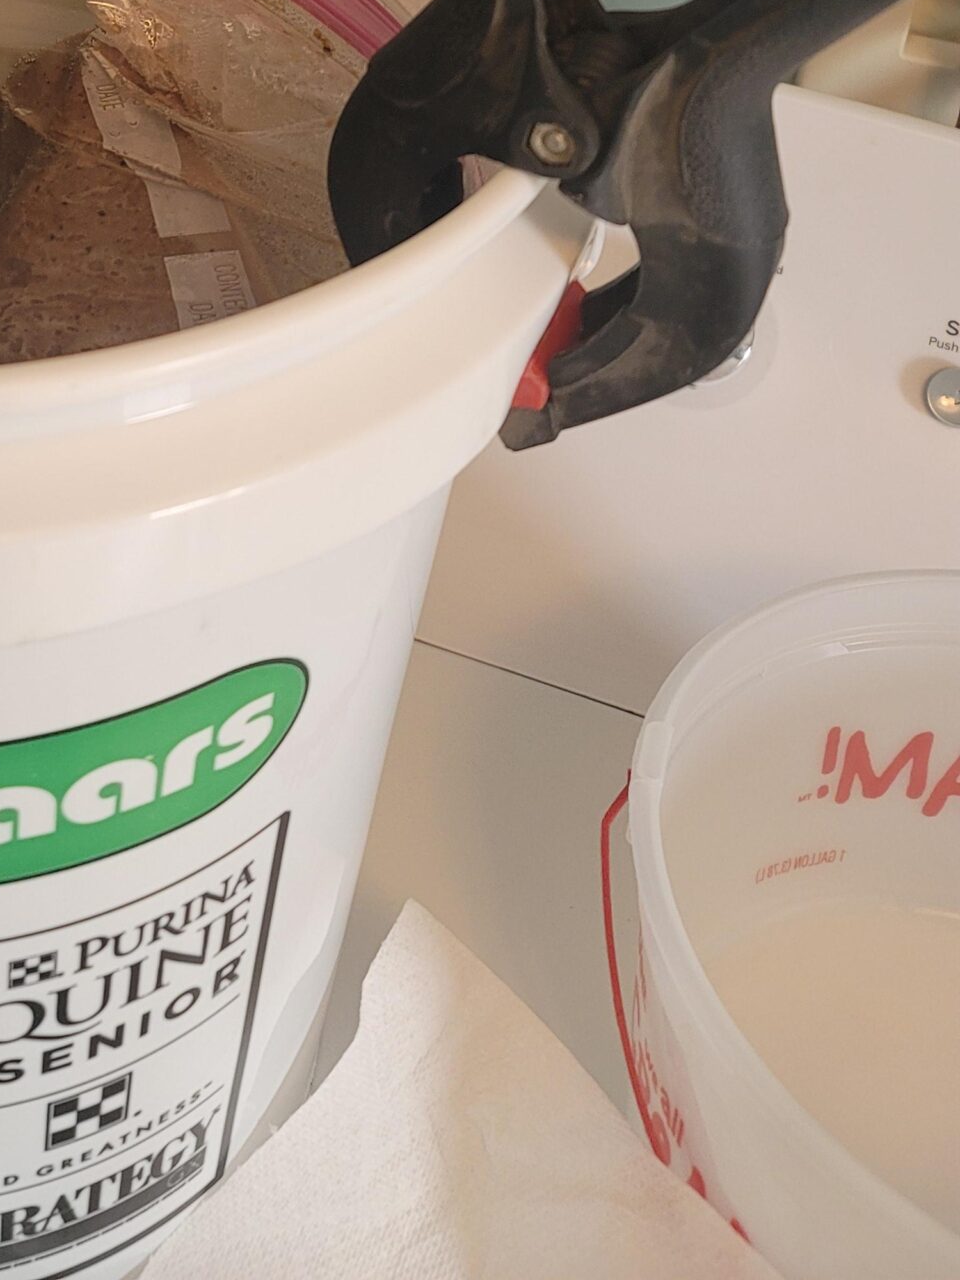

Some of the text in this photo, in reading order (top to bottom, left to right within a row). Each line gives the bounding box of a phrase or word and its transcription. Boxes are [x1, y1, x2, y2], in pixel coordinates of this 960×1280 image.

[96, 84, 125, 111] DATE
[928, 336, 959, 353] Push
[73, 859, 256, 975] PURINA
[36, 1089, 202, 1177] GREATNESS
